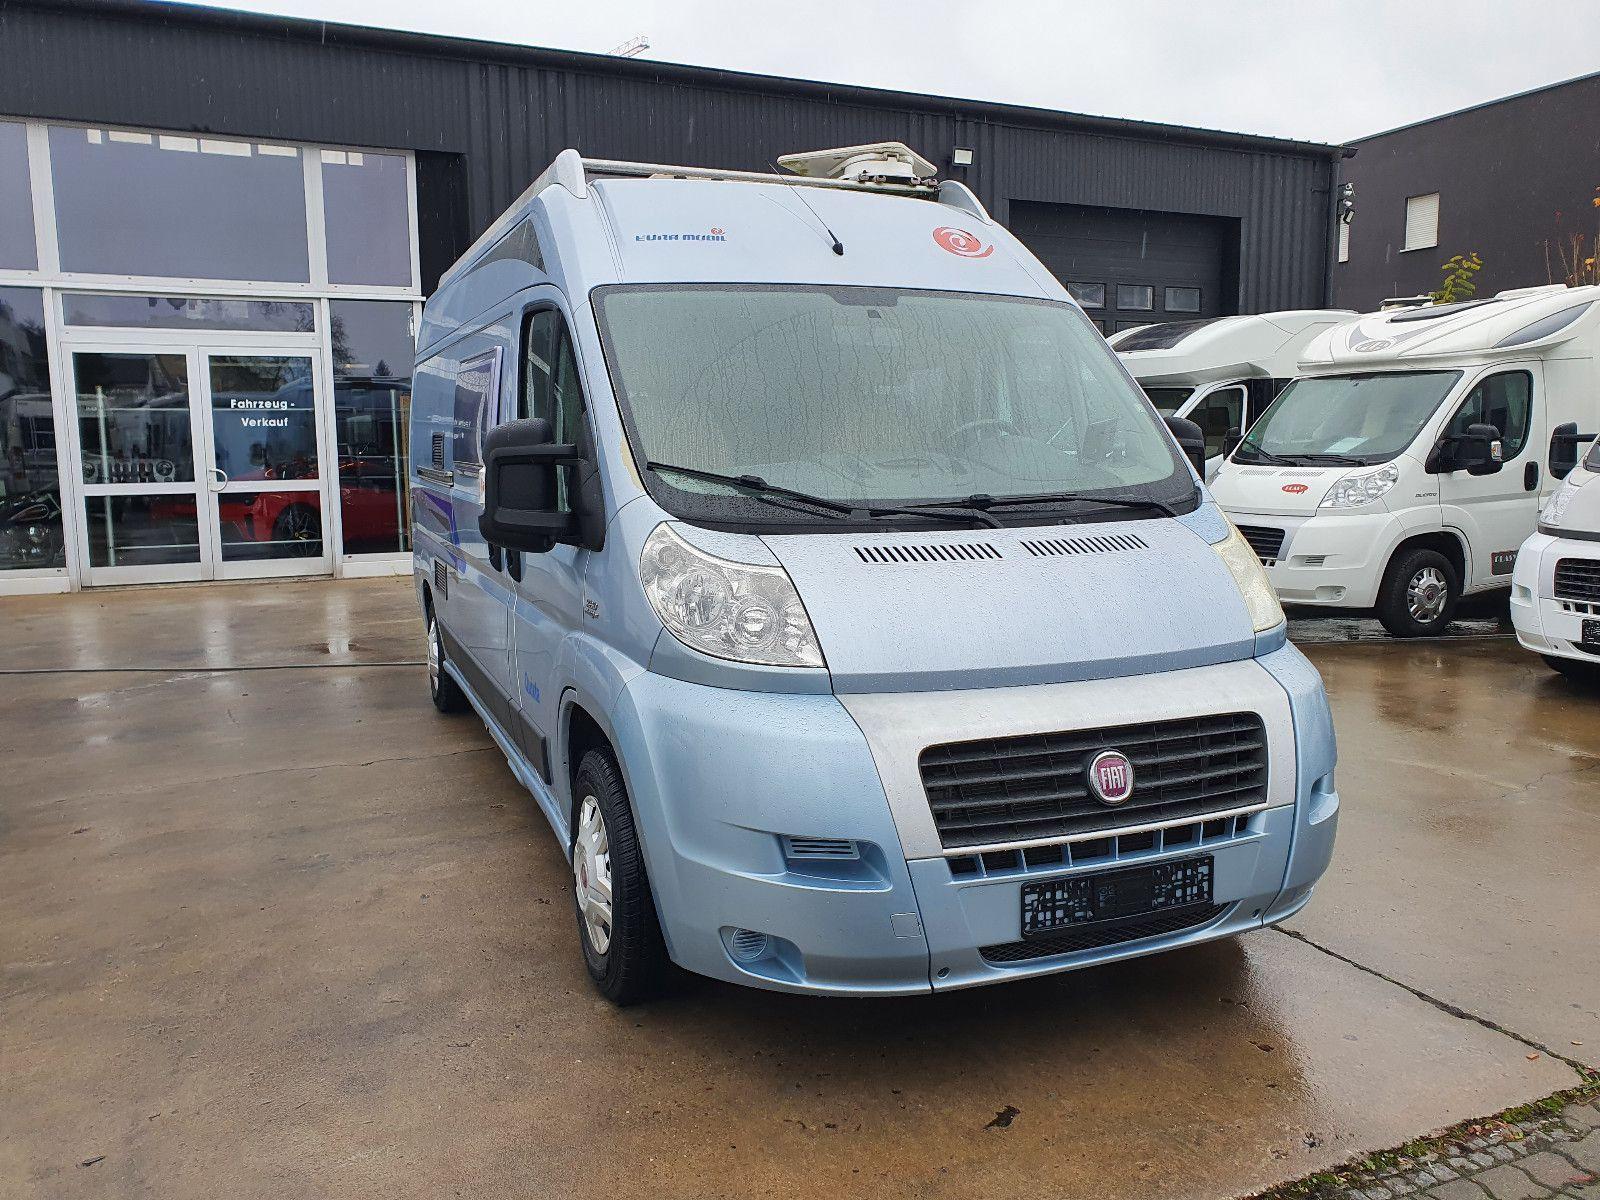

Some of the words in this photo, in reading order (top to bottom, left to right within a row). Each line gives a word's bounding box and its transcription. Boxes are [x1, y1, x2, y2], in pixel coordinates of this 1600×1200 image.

[635, 234, 679, 242] EURA
[682, 234, 727, 242] MOBIL
[230, 399, 288, 411] Fahrzeug
[241, 417, 288, 427] Verkauf
[1100, 765, 1125, 790] FIAT
